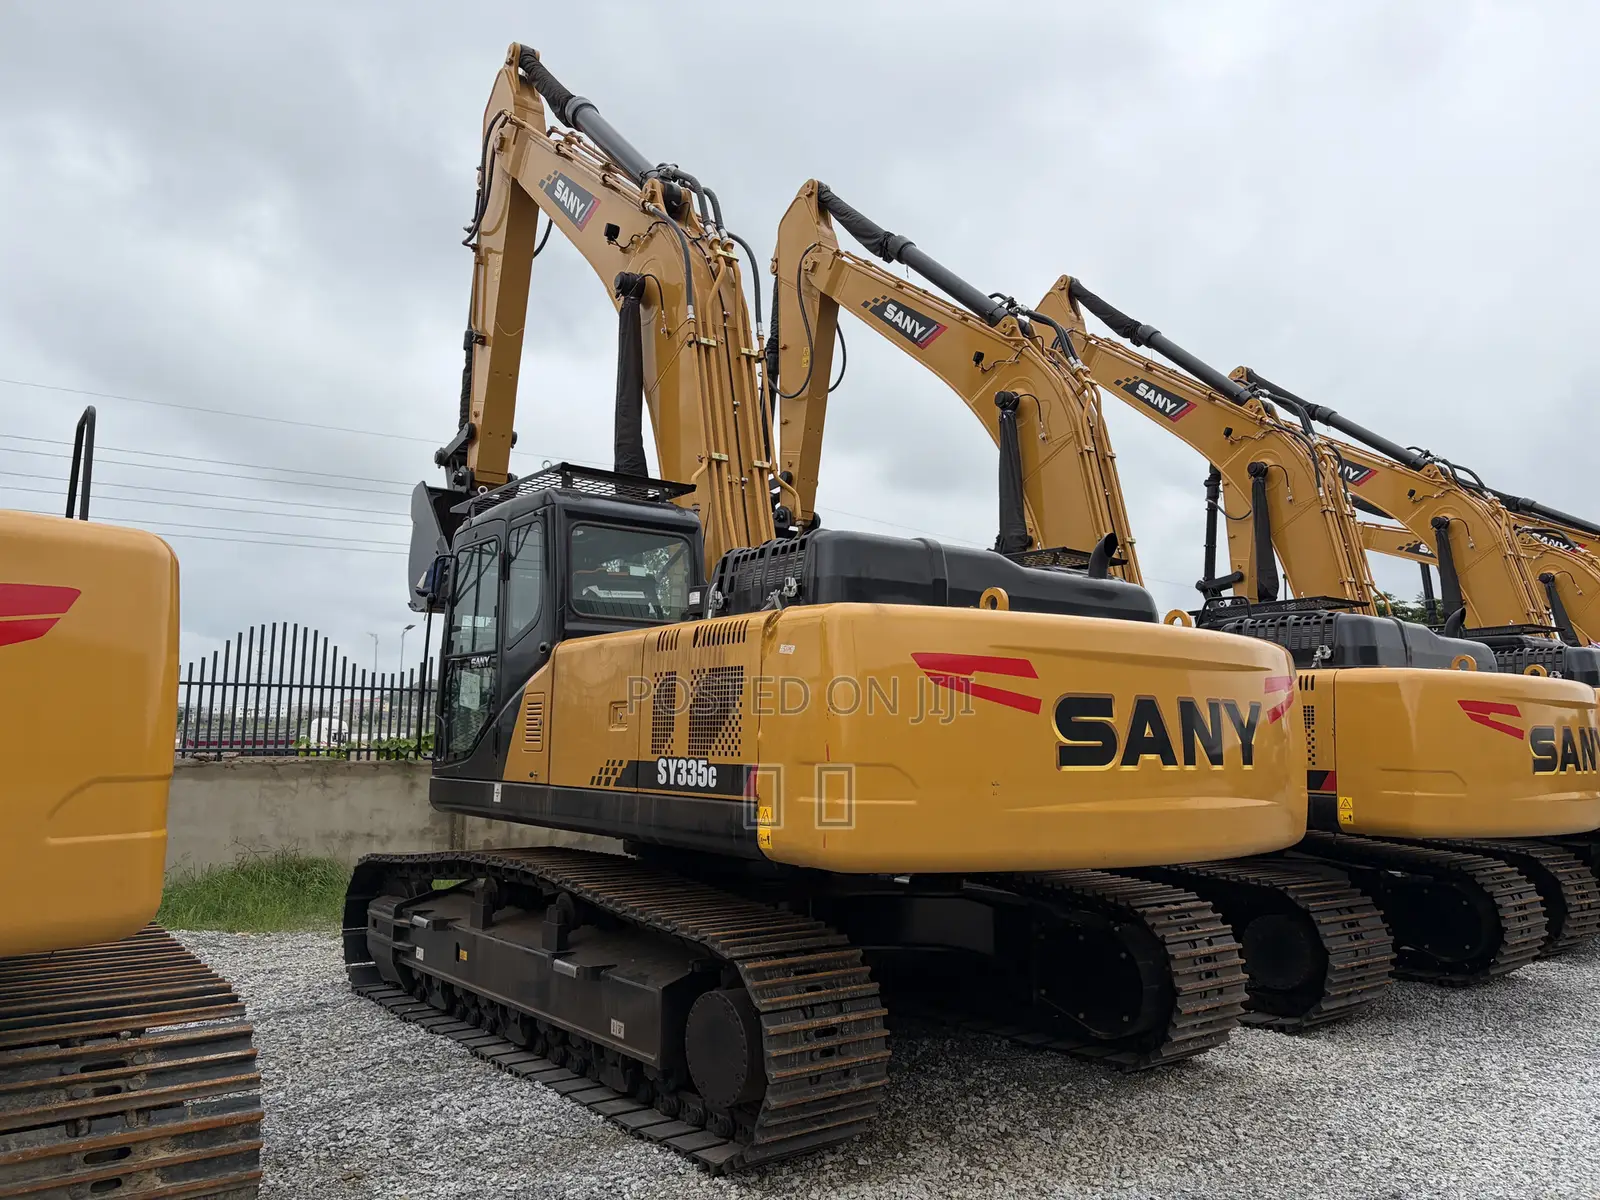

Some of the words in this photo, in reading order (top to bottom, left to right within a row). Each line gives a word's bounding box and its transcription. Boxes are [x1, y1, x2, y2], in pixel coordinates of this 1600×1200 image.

[554, 179, 585, 219] SANY
[883, 303, 926, 339] SANY
[1135, 382, 1177, 413] SANY
[470, 656, 491, 669] SANY
[1052, 692, 1262, 771] SANY
